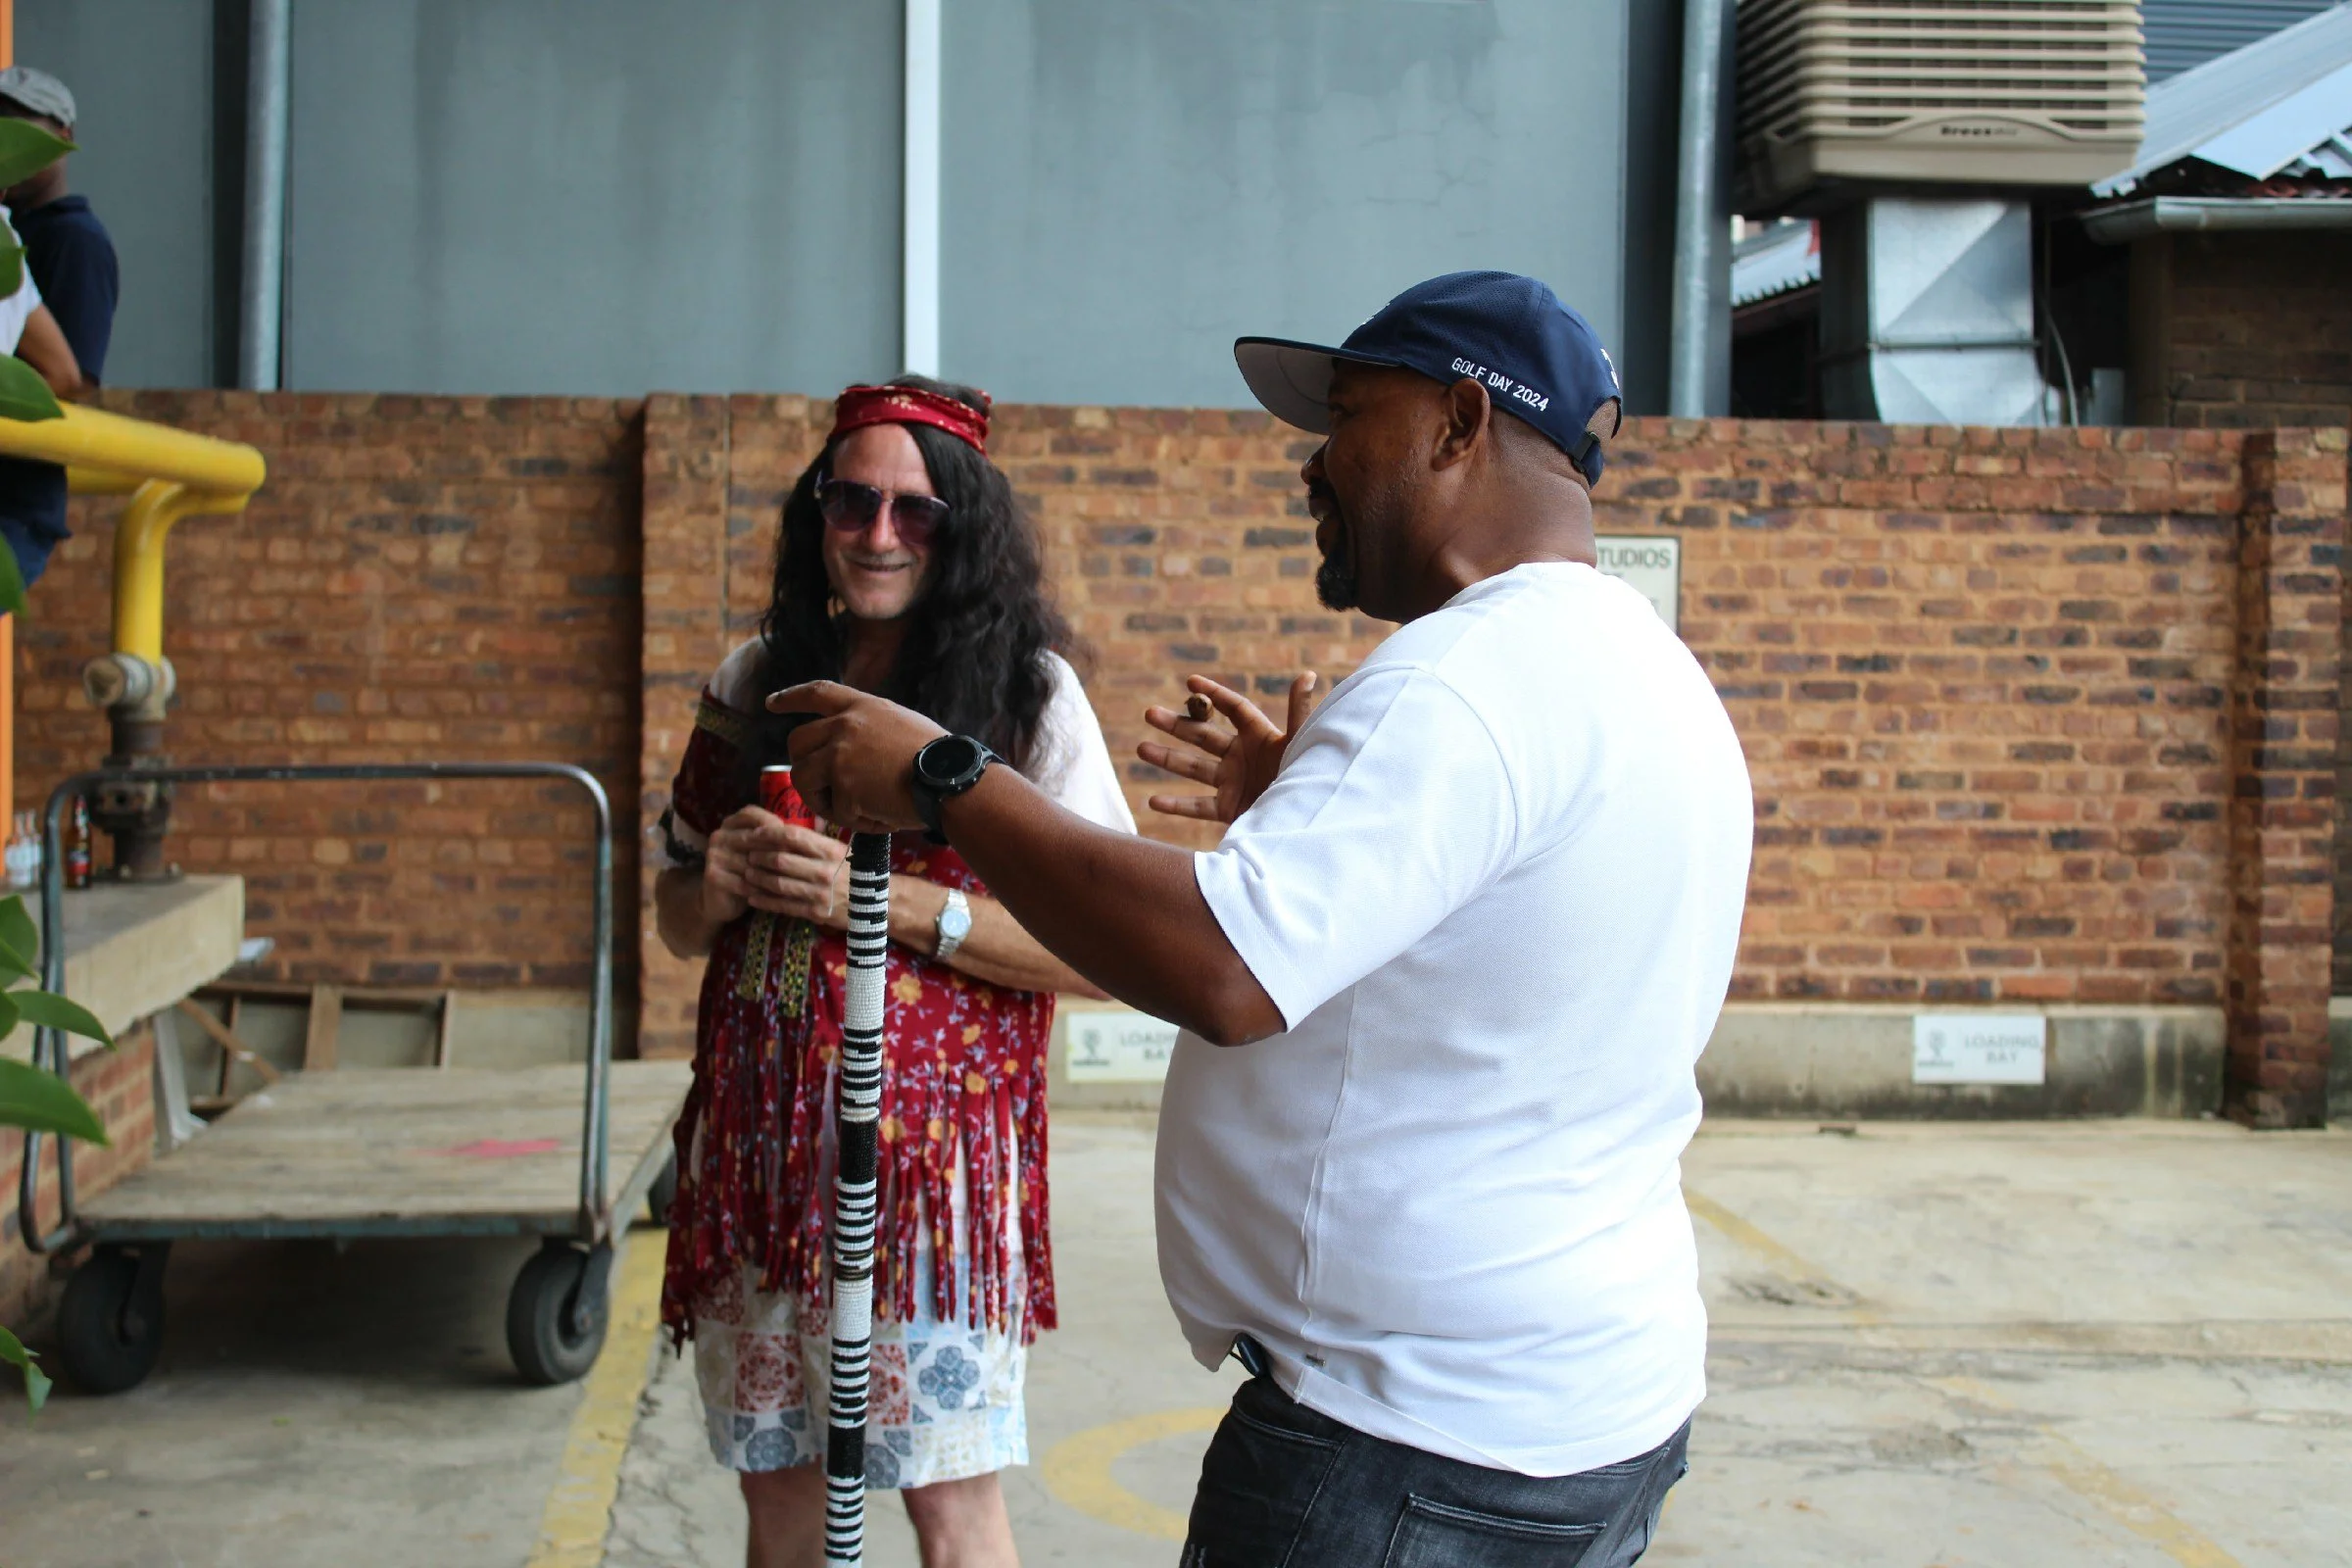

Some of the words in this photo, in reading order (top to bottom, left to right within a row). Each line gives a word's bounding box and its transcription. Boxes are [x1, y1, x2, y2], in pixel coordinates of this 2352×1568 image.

[1451, 357, 1487, 379] GOLF
[1488, 371, 1514, 392] DAY
[1513, 385, 1549, 412] 2024
[1597, 547, 1672, 568] TUDIOS
[1964, 1032, 2040, 1050] LOADING
[1986, 1052, 2018, 1064] BAY
